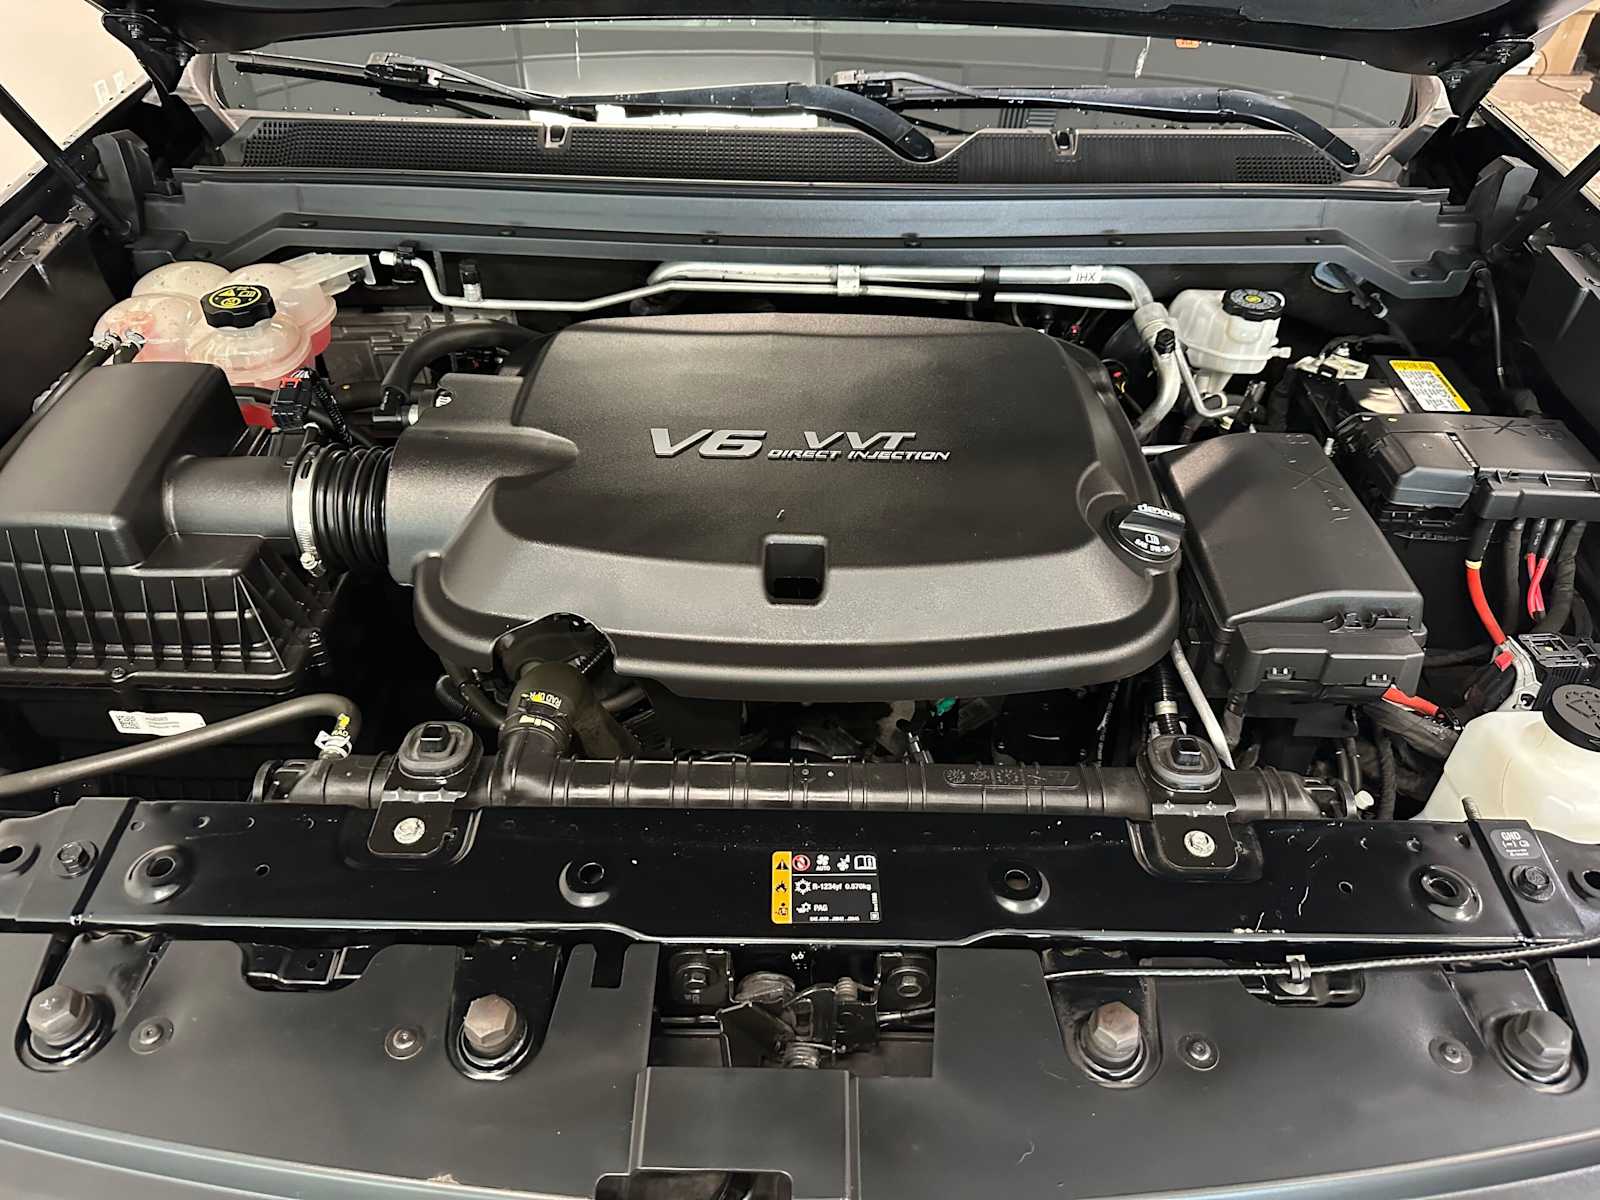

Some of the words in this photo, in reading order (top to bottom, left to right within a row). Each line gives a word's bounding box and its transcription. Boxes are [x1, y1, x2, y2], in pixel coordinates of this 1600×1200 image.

[650, 427, 767, 459] V6
[803, 431, 917, 450] VVT
[768, 449, 841, 460] DIRECT
[848, 450, 951, 461] INJECTION
[811, 882, 843, 892] R-1234yf
[813, 903, 829, 912] PAG
